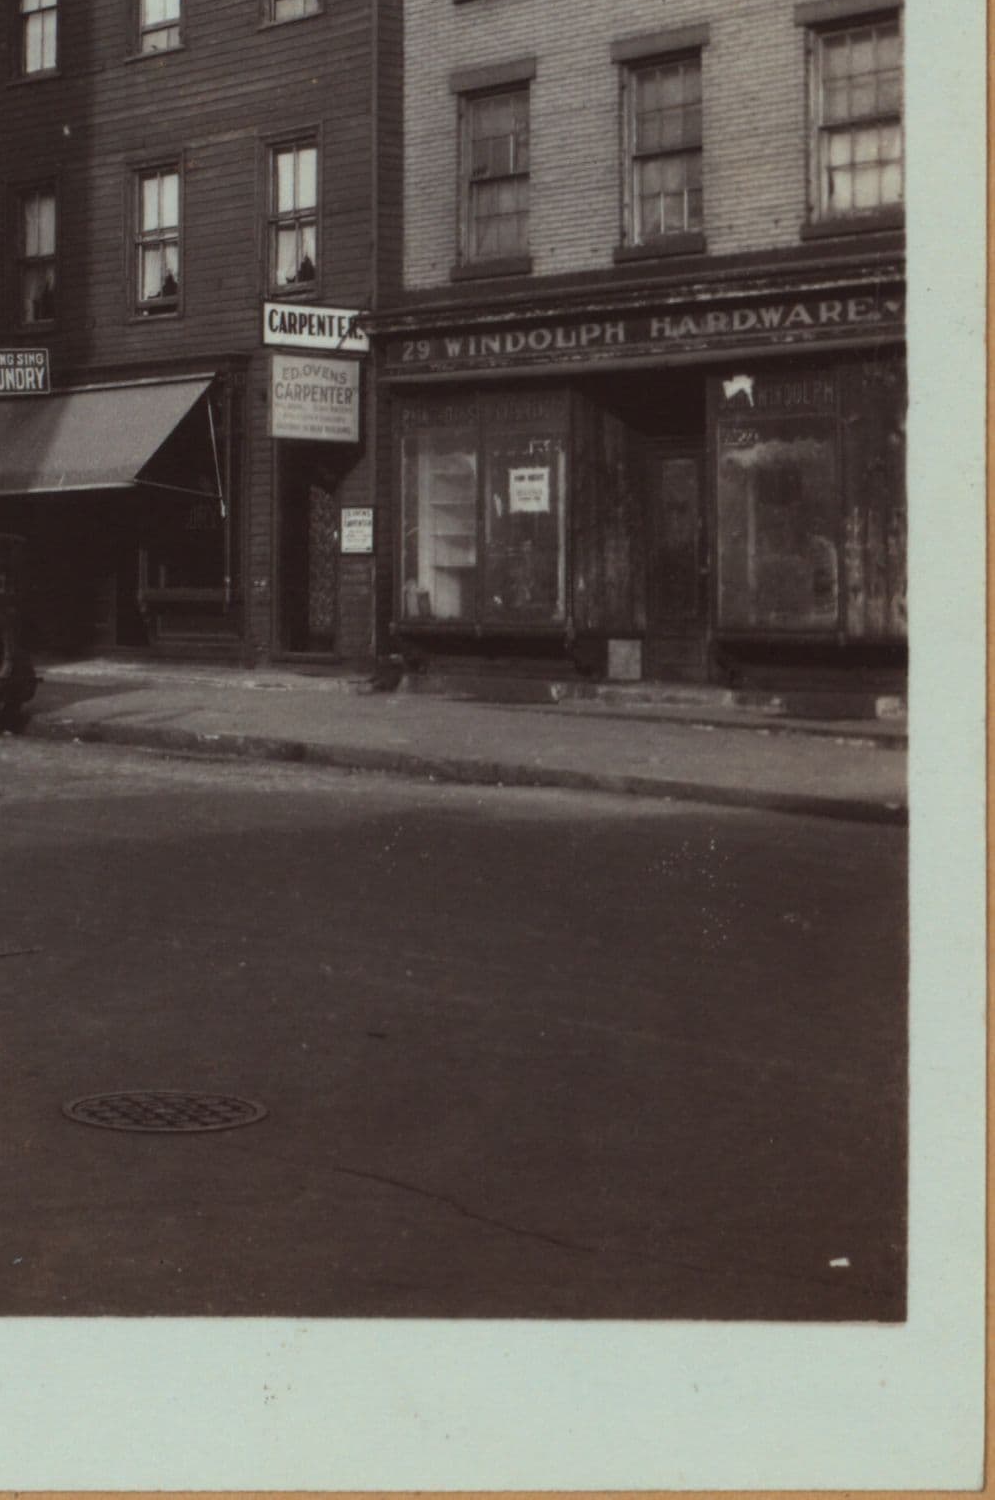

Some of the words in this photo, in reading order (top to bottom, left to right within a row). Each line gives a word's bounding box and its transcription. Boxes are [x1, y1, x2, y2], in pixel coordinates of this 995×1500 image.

[400, 339, 430, 362] 29
[443, 320, 625, 357] WINDOLPH
[16, 352, 44, 366] SING
[302, 363, 348, 385] OVENS
[274, 382, 354, 405] CARPENTER
